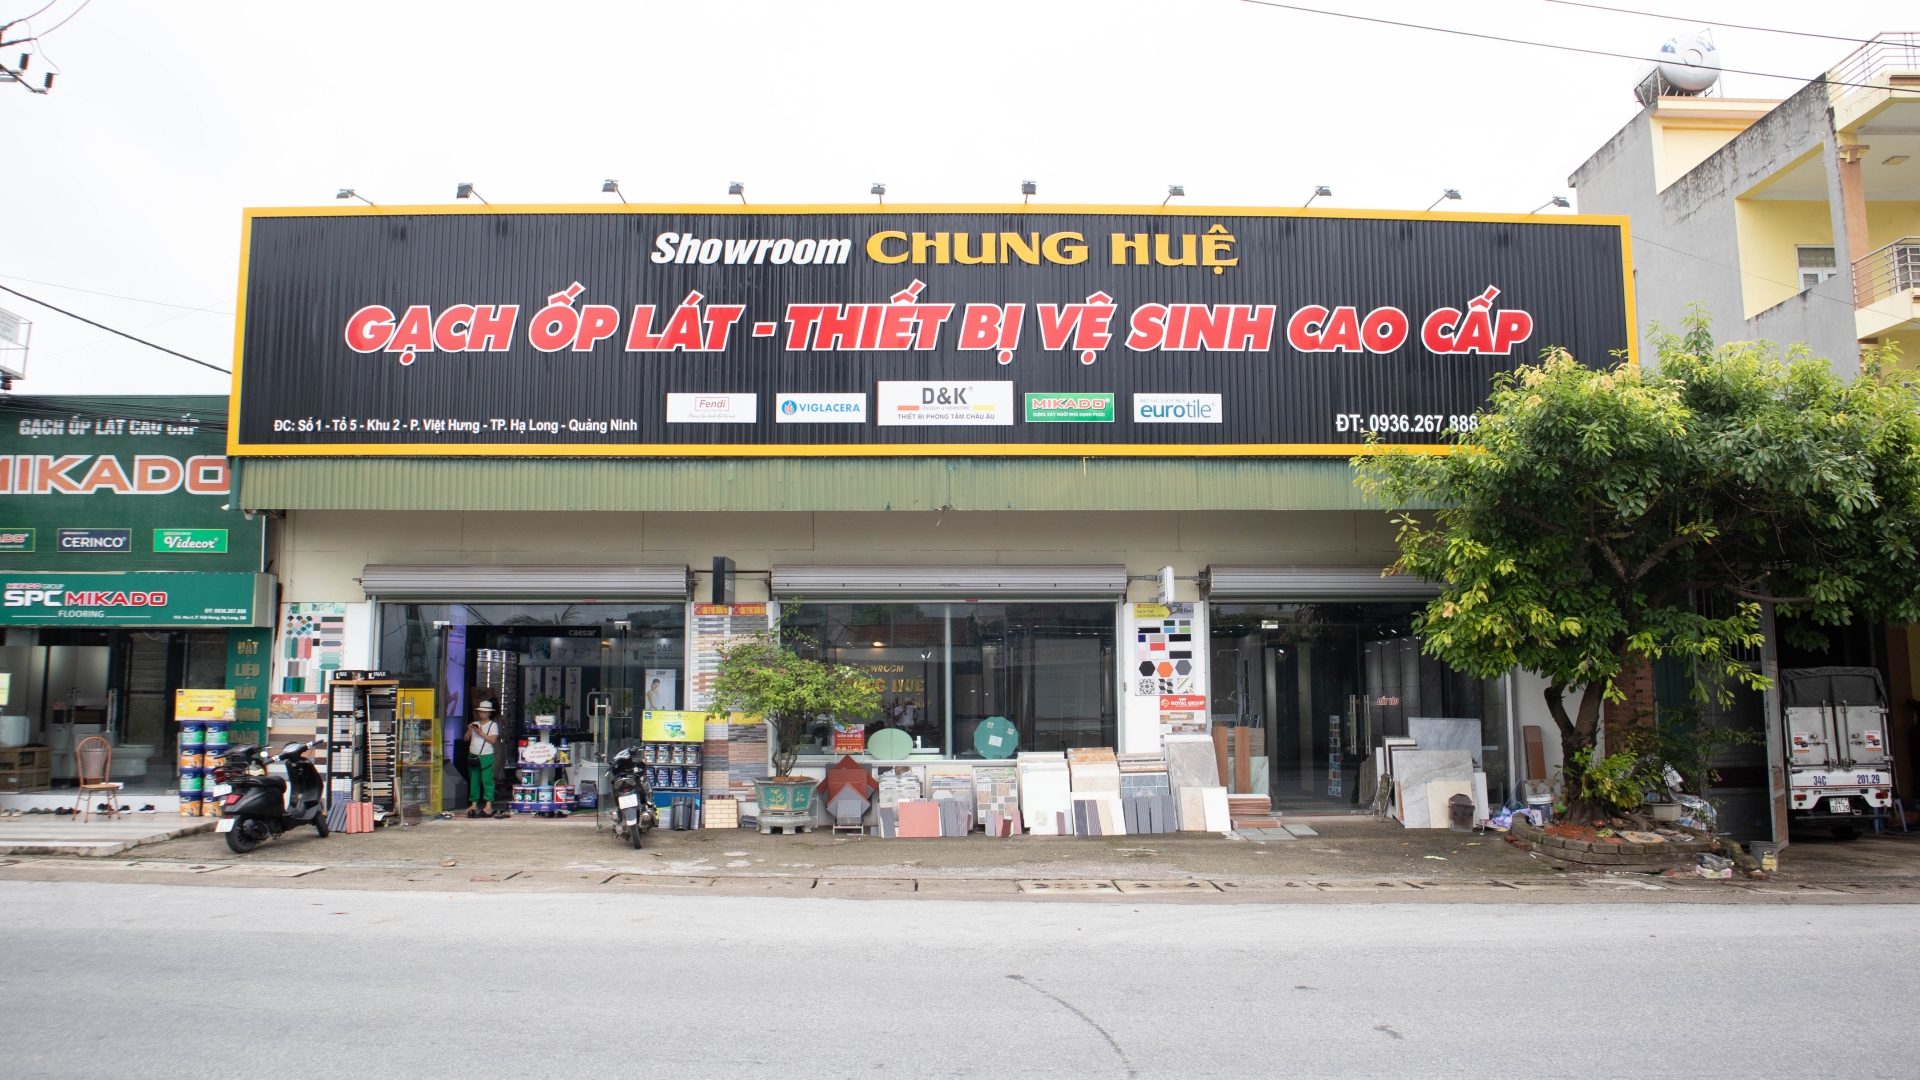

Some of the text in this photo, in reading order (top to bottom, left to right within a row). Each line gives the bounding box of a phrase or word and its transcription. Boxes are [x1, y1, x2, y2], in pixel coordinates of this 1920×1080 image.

[650, 224, 1240, 275] Showroom CHUNG HUỆ
[344, 303, 520, 366] GẠCH
[528, 280, 620, 353] ỐP
[624, 289, 746, 353] LÁT
[784, 278, 956, 351] THIẾT
[957, 303, 1026, 365] BỊ
[1036, 290, 1118, 365] VỆ
[1125, 303, 1277, 353] SINH
[1287, 304, 1410, 355] CAO
[1421, 284, 1534, 356] CẤP
[922, 387, 968, 405] D&K
[699, 399, 727, 409] Fendi
[799, 403, 861, 413] VIGLACERA
[1032, 398, 1107, 410] MIKADO
[1140, 399, 1212, 418] eurotile
[897, 412, 916, 420] THIẾT
[926, 412, 948, 420] PHÒNG
[967, 412, 985, 420] CHÂU
[1336, 413, 1364, 432] ĐT:
[273, 419, 295, 432] ĐC:
[298, 416, 314, 432] Số
[315, 419, 322, 432] 1
[332, 416, 347, 432] Tổ
[350, 419, 357, 432] 5
[366, 419, 390, 432] Khu
[392, 419, 400, 432] 2
[410, 419, 421, 432] P.
[423, 418, 446, 434] Việt
[448, 418, 480, 434] Hưng
[490, 419, 508, 432] TP.
[510, 418, 526, 434] Hạ
[529, 418, 559, 434] Long
[569, 418, 607, 434] Quảng
[610, 418, 638, 432] Ninh
[61, 536, 123, 548] CERINCO
[164, 535, 215, 549] Videcor
[4, 590, 168, 607] SPC MIKADO
[58, 610, 105, 618] FLOORING
[657, 643, 673, 652] D&K
[1813, 774, 1880, 786] 34C 201.29
